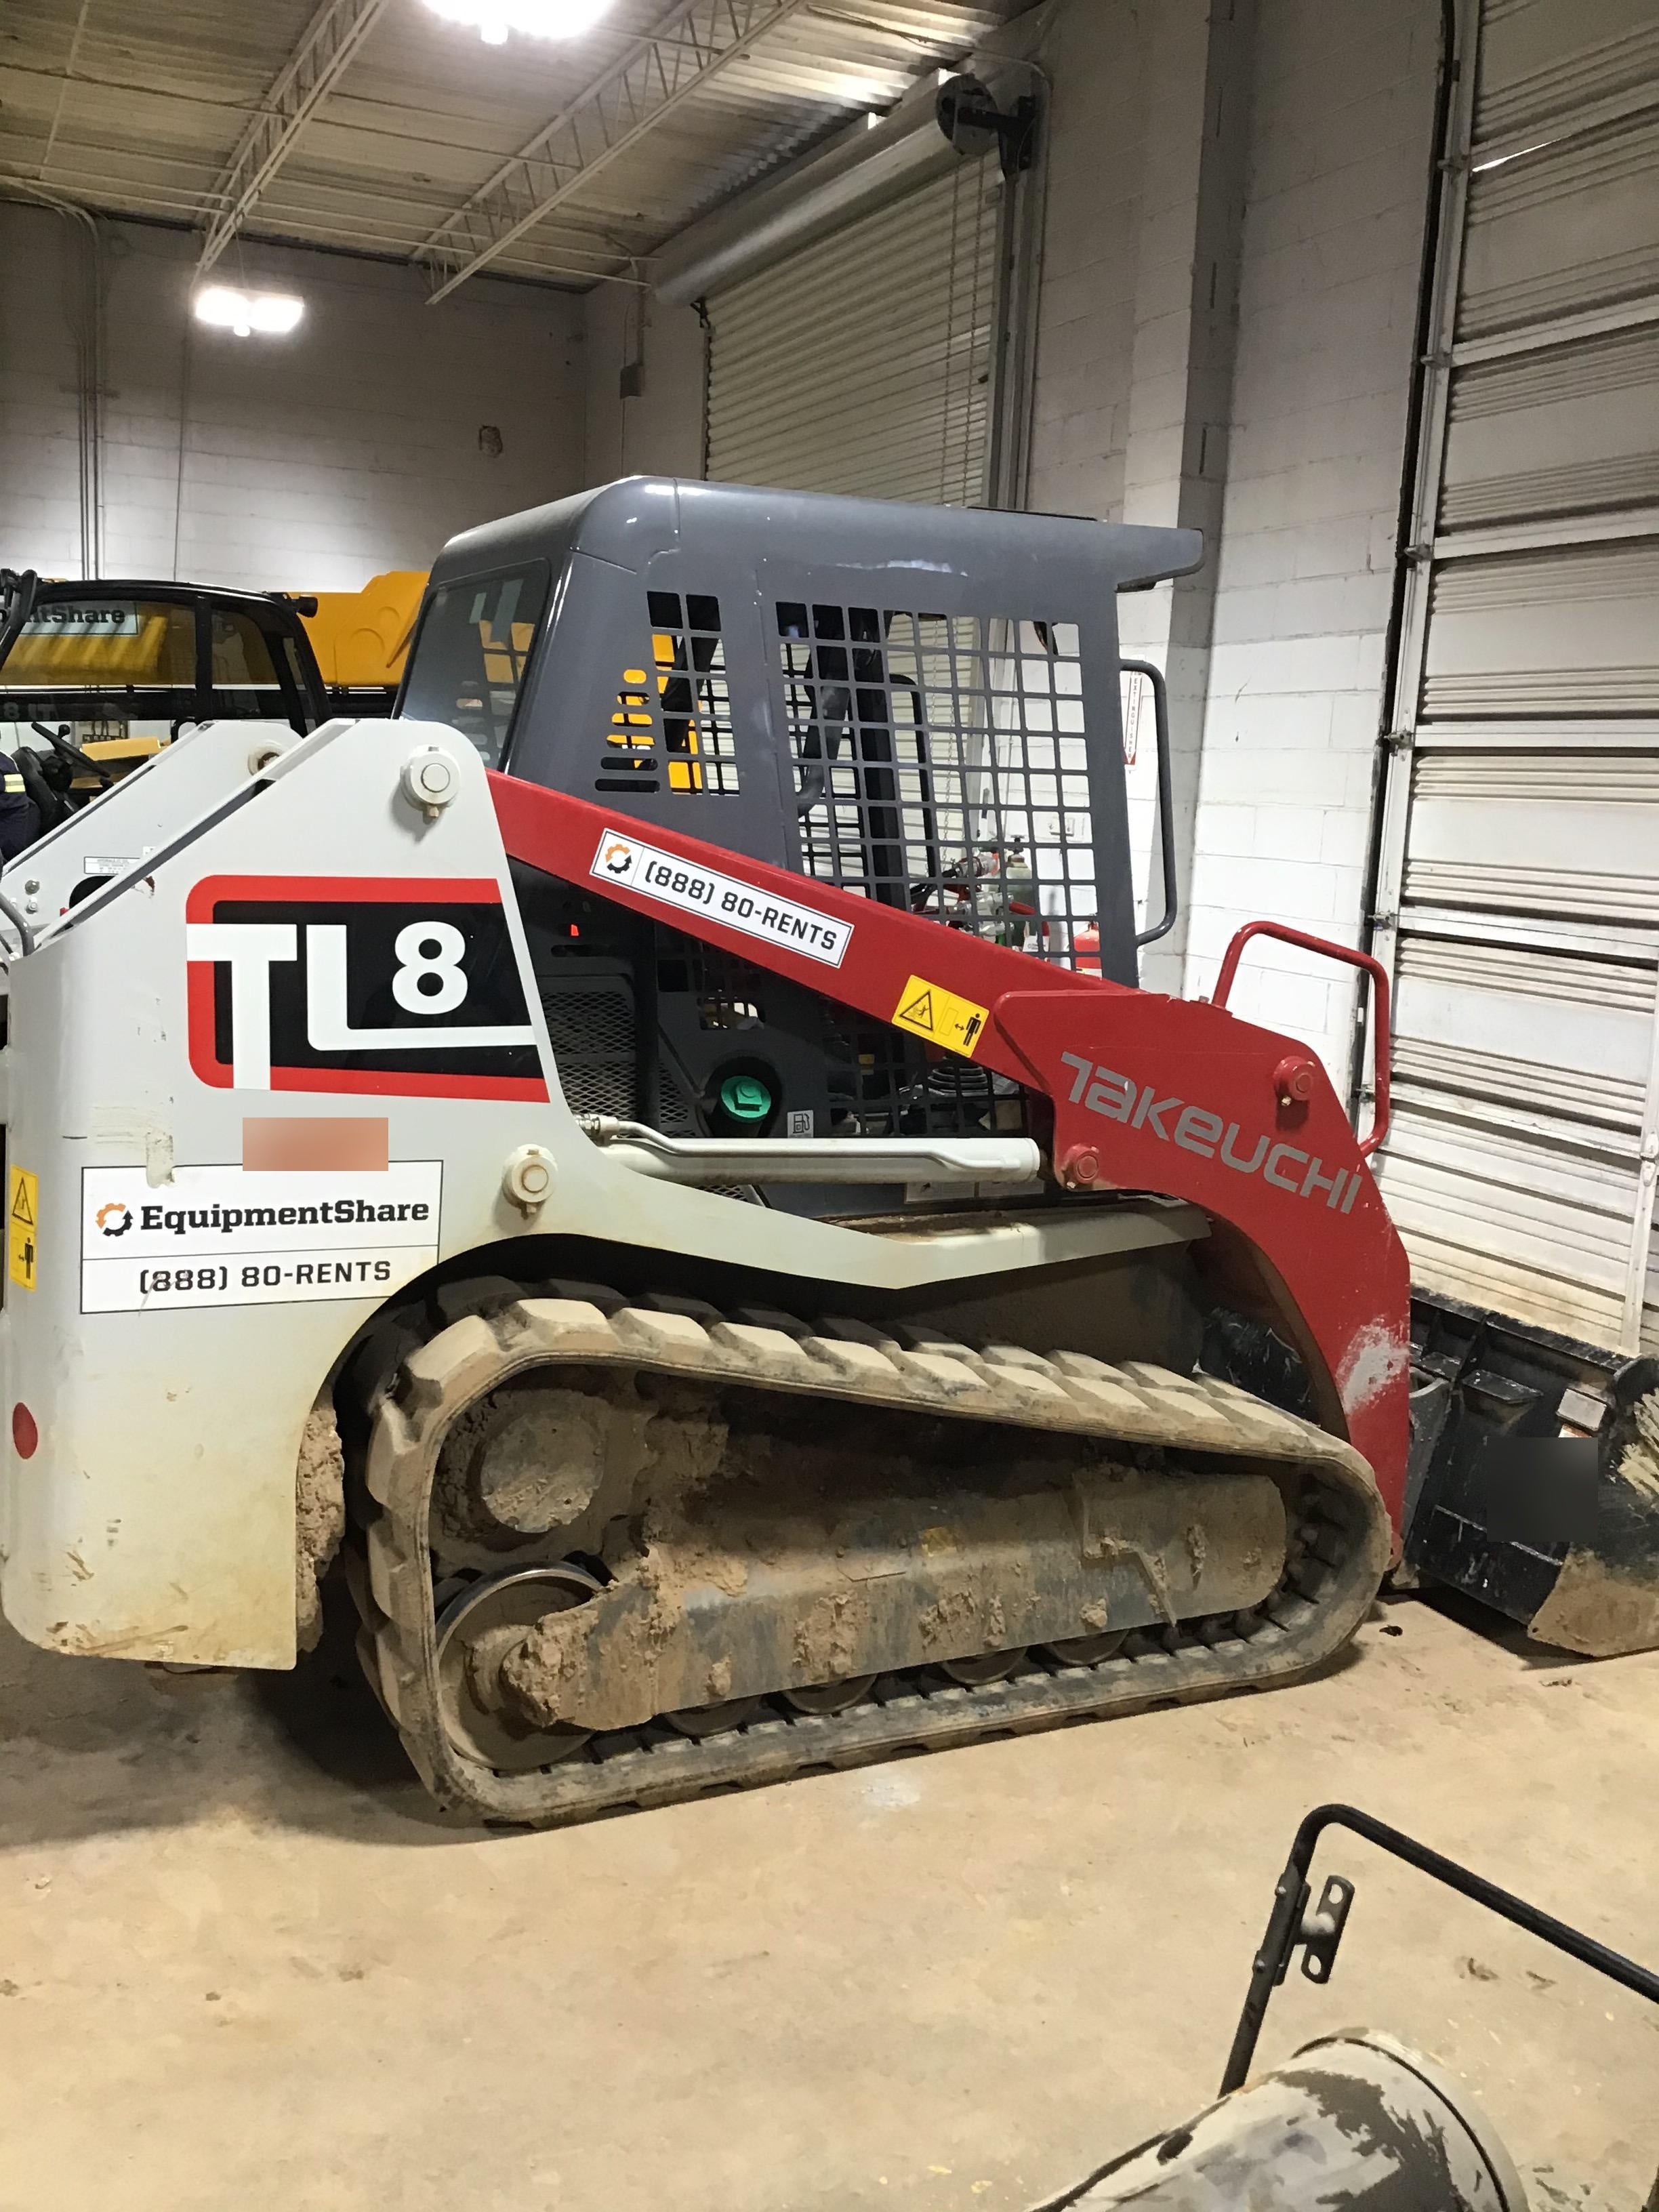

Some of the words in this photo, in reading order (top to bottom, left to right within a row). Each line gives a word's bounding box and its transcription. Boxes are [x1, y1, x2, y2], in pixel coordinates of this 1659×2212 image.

[1128, 678, 1139, 758] EXTINGUISHER
[644, 861, 715, 905] (888)
[721, 891, 837, 950] 80-RENTS
[186, 921, 537, 1090] TL8
[140, 1200, 429, 1235] EquipmentShare
[140, 1267, 228, 1294] (888)
[241, 1261, 391, 1287] 80-RENTS
